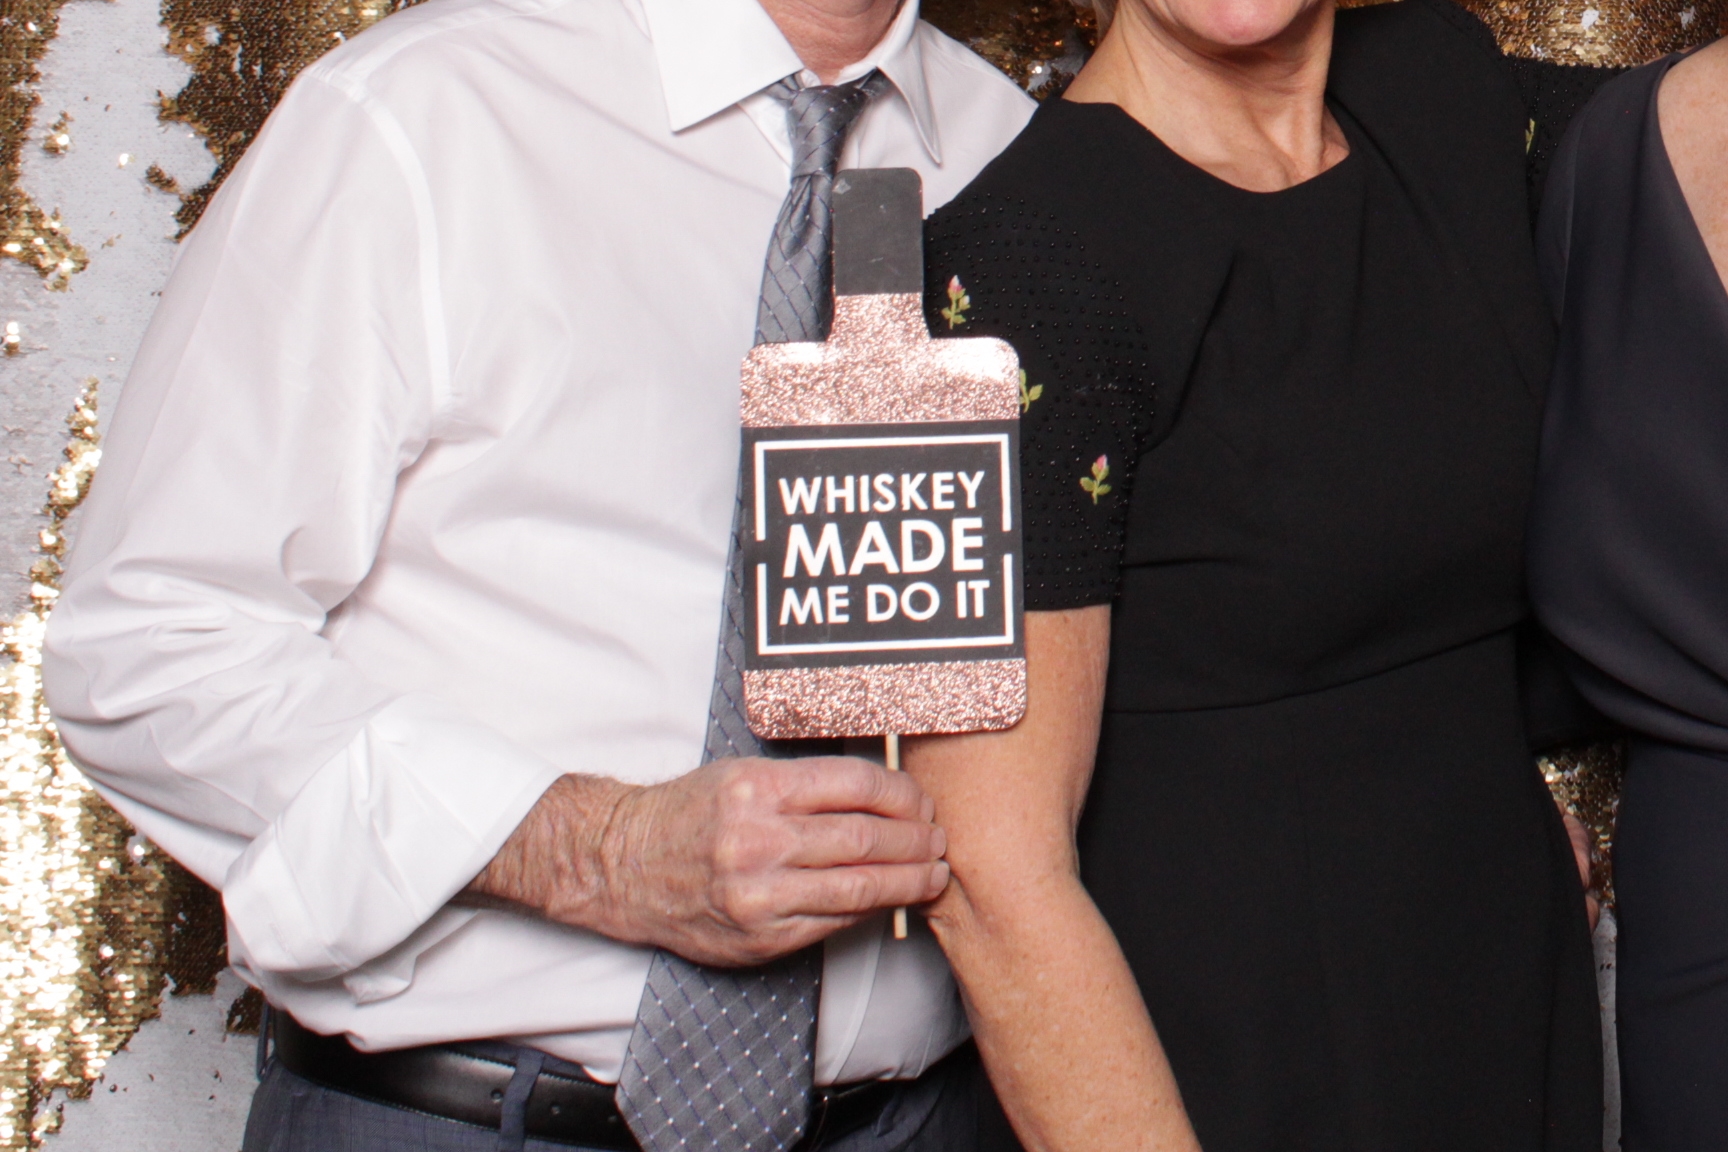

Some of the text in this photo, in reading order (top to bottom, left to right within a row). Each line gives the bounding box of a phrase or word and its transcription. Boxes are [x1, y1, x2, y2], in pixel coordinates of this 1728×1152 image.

[778, 471, 986, 515] WHISKEY
[782, 517, 985, 578] MADE
[779, 579, 991, 626] ME DO IT
